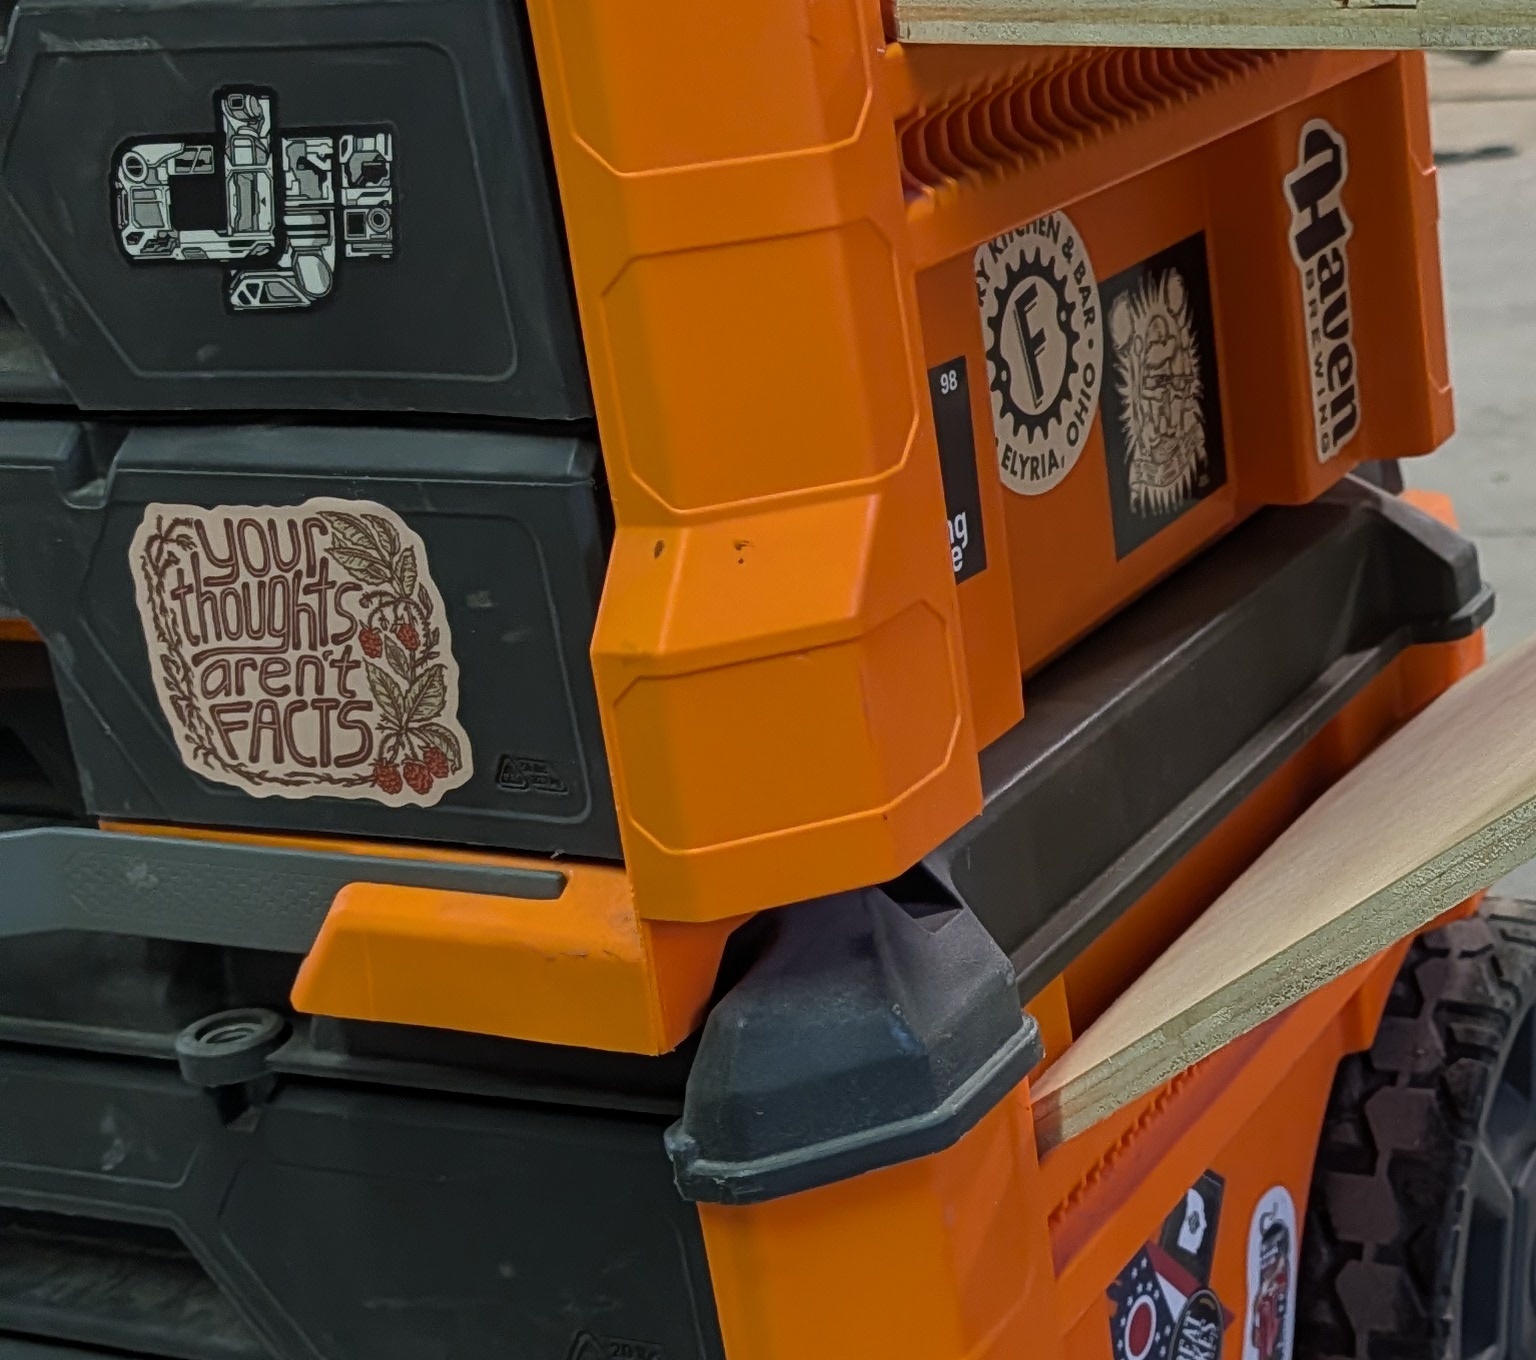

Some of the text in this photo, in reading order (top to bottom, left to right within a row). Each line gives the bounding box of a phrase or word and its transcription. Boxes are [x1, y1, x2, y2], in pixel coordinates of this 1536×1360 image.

[1073, 260, 1096, 329] BAR
[940, 369, 958, 395] 98
[1305, 267, 1332, 455] BREWING
[1066, 362, 1095, 447] OHIO
[193, 516, 331, 587] your
[171, 551, 362, 667] thoughts
[209, 697, 374, 769] FACTS
